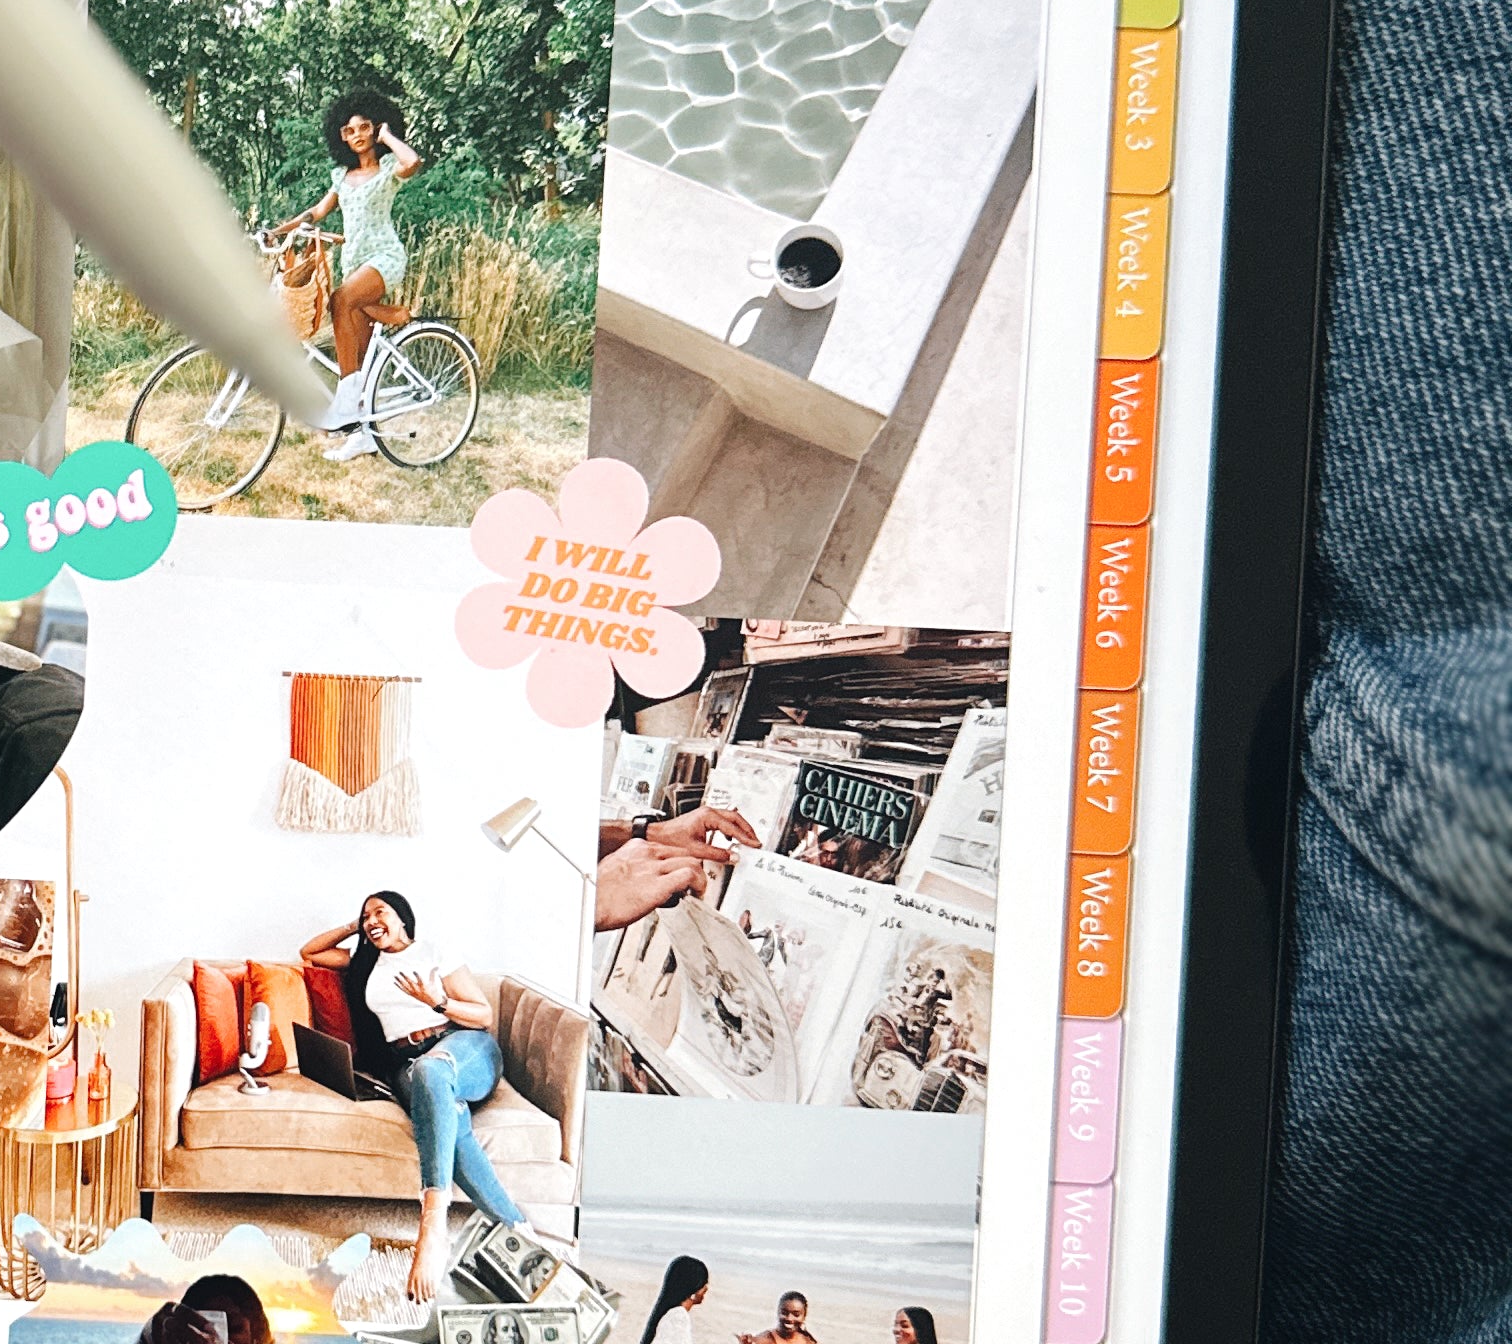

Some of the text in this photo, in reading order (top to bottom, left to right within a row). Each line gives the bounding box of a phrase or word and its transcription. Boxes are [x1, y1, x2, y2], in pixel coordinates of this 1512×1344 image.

[1124, 40, 1160, 151] Week 3
[1115, 207, 1150, 318] Week 4
[1104, 373, 1140, 483] Week 5
[25, 467, 154, 553] good
[525, 535, 653, 581] I WILL
[502, 605, 659, 656] THINGS.
[518, 572, 657, 618] DO BIG
[1094, 538, 1130, 649] Week 6
[804, 768, 915, 821] CAHIERS
[1085, 703, 1121, 814] Week 7
[799, 793, 904, 850] CINEMA
[1076, 867, 1113, 978] Week 8
[1067, 1031, 1102, 1142] Week 9
[1058, 1187, 1093, 1315] Week 10
